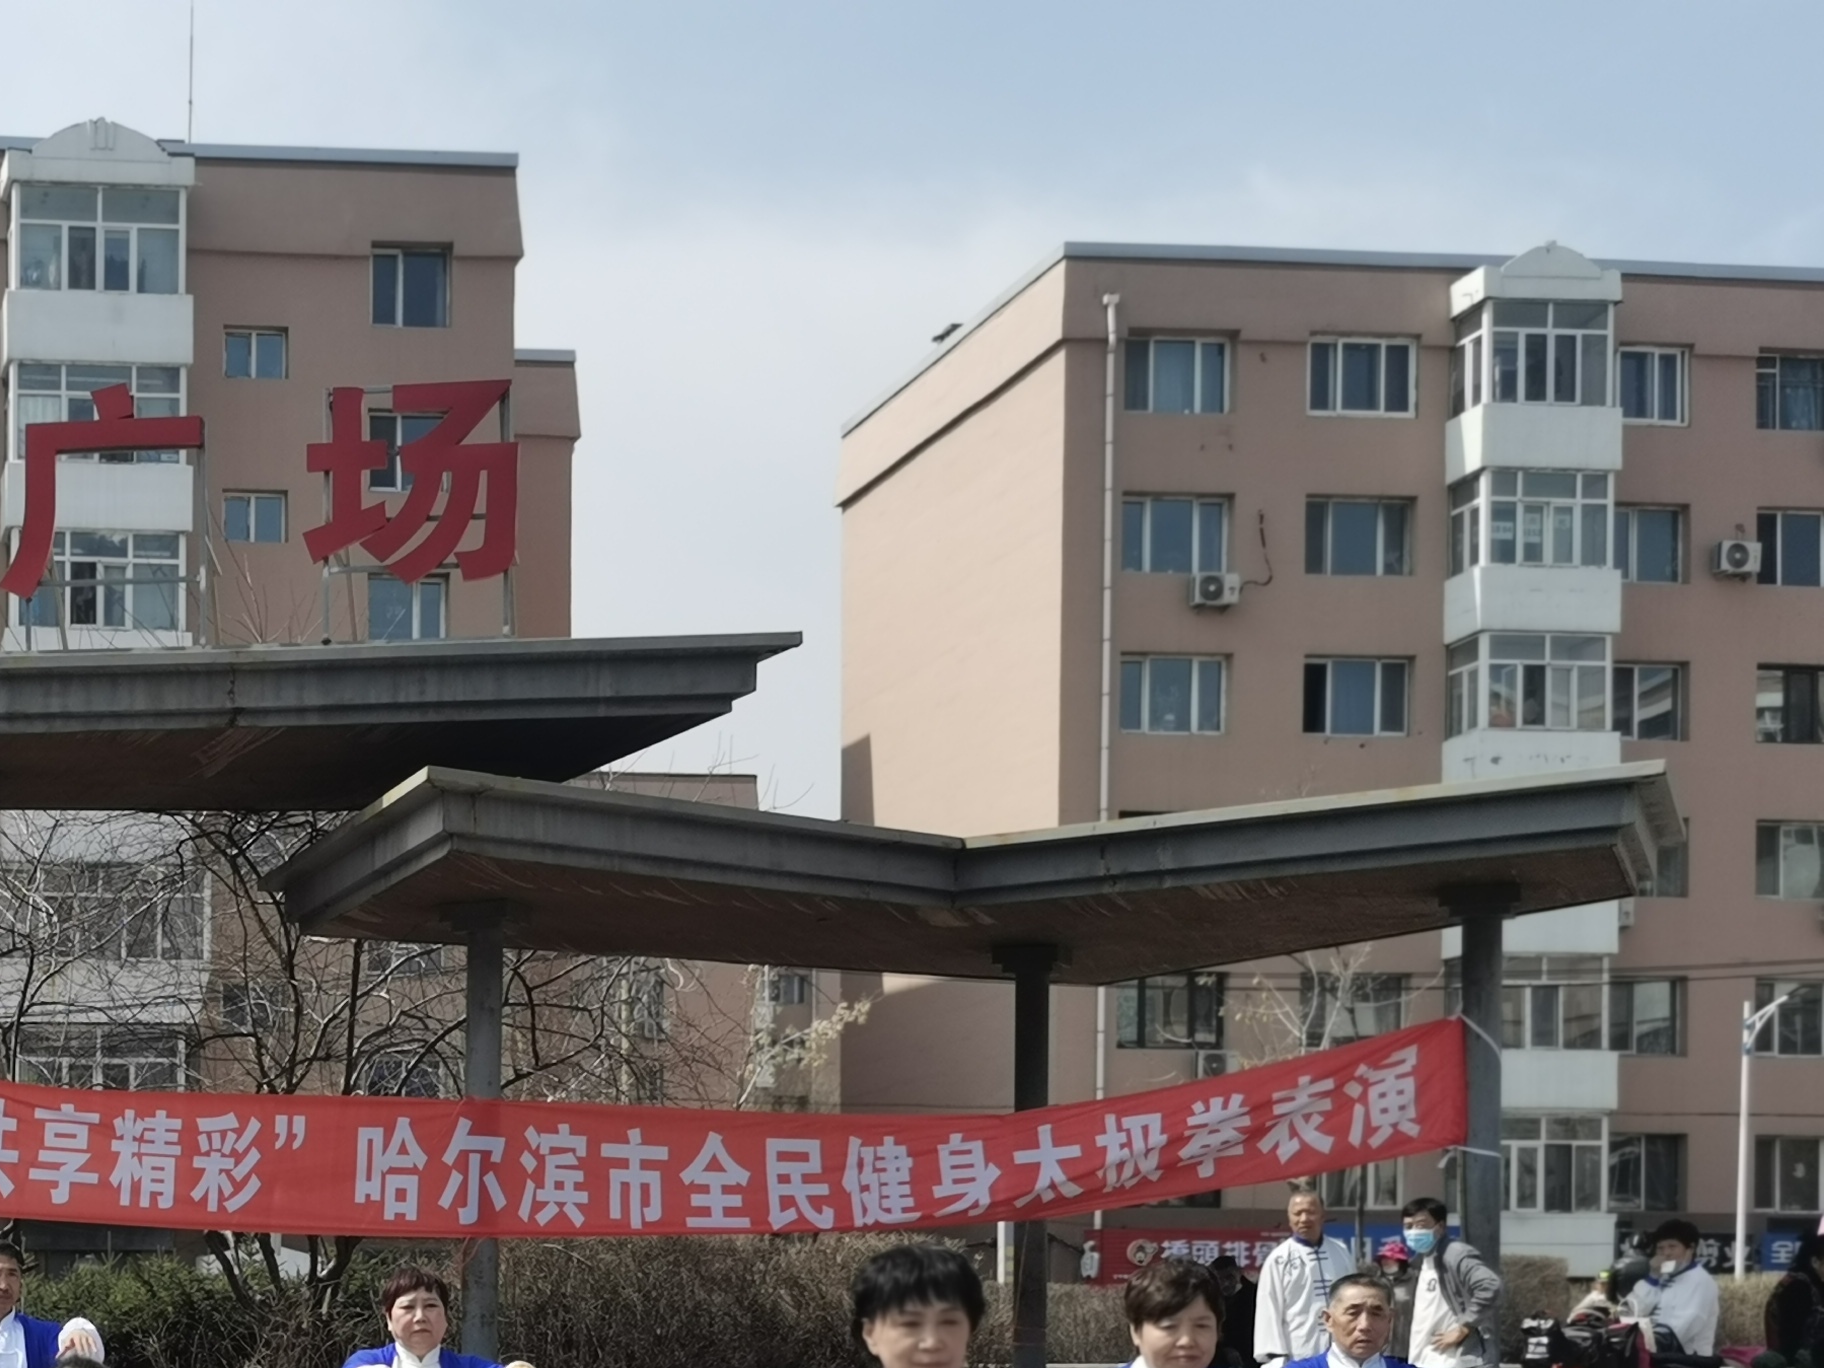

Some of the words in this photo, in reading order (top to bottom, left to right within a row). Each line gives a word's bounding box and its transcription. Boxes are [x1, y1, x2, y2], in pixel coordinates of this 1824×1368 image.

[353, 1042, 1422, 1232] 哈尔滨市全民健身太极拳表演
